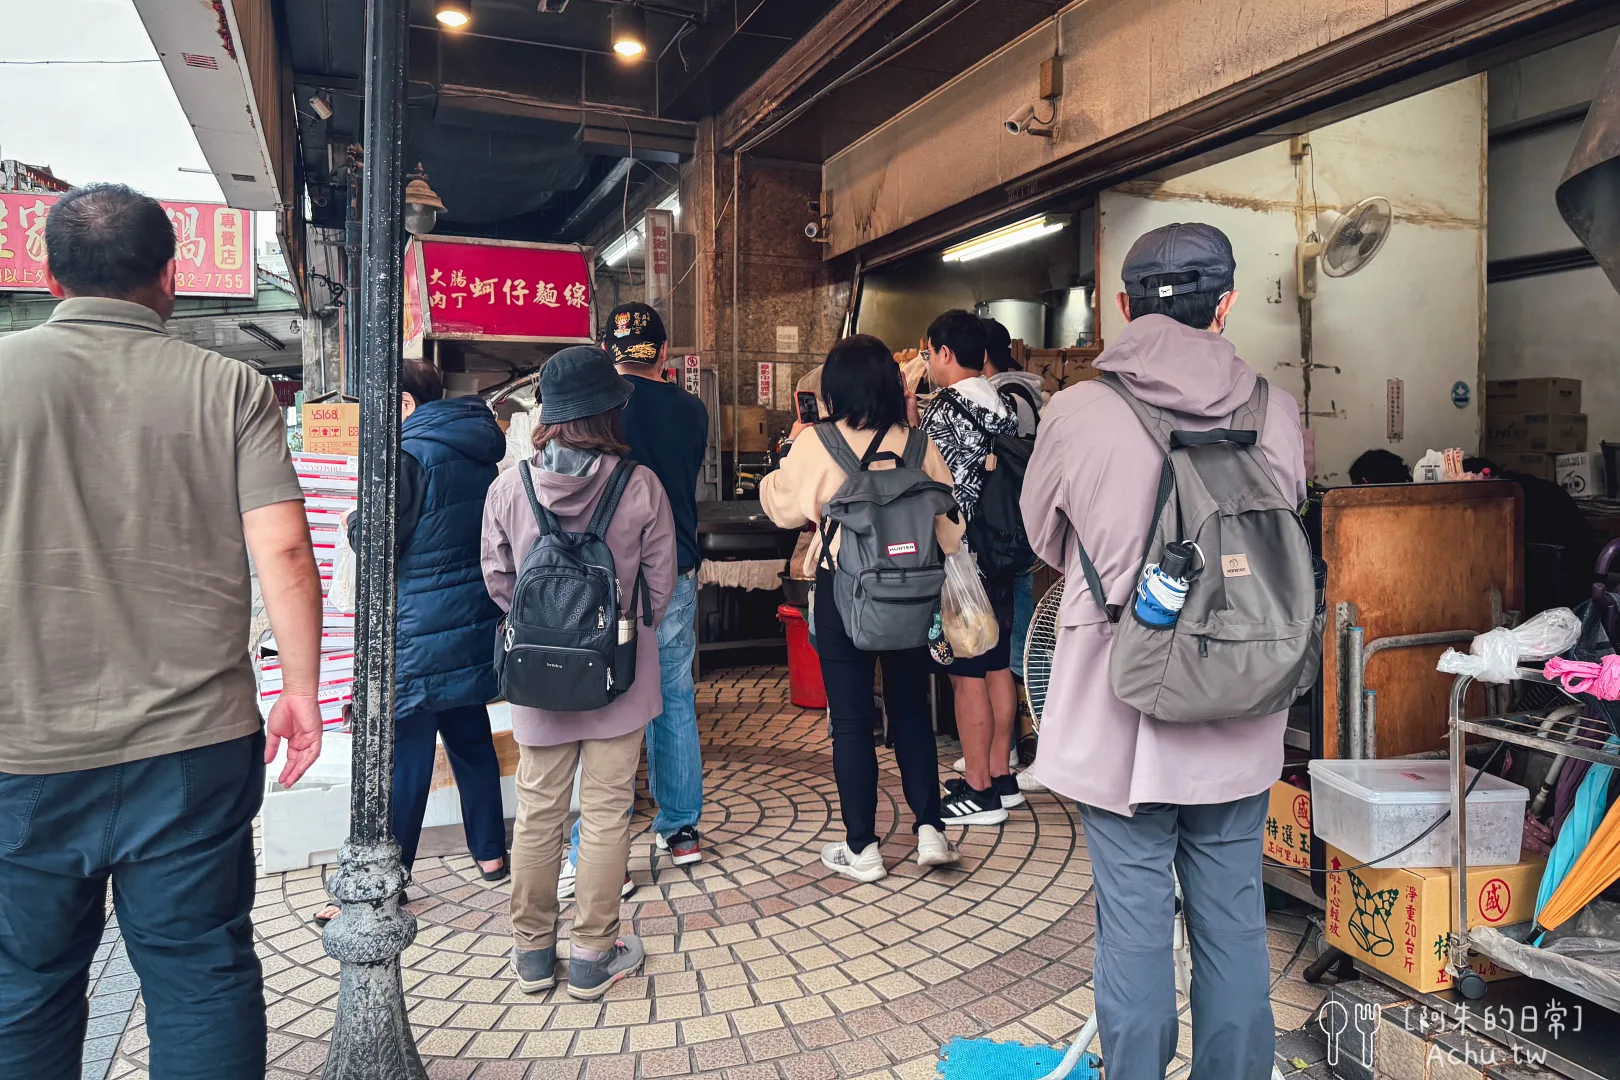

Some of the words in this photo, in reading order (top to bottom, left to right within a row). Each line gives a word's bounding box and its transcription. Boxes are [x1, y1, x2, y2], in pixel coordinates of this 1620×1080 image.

[220, 212, 237, 266] 專賣店
[429, 268, 467, 288] 大腸
[469, 277, 591, 309] 蚵仔麵線
[429, 291, 467, 309] 肉丁
[1329, 885, 1341, 938] 小心輕放
[1485, 883, 1503, 914] 盛
[1404, 885, 1417, 974] 淨重20台斤
